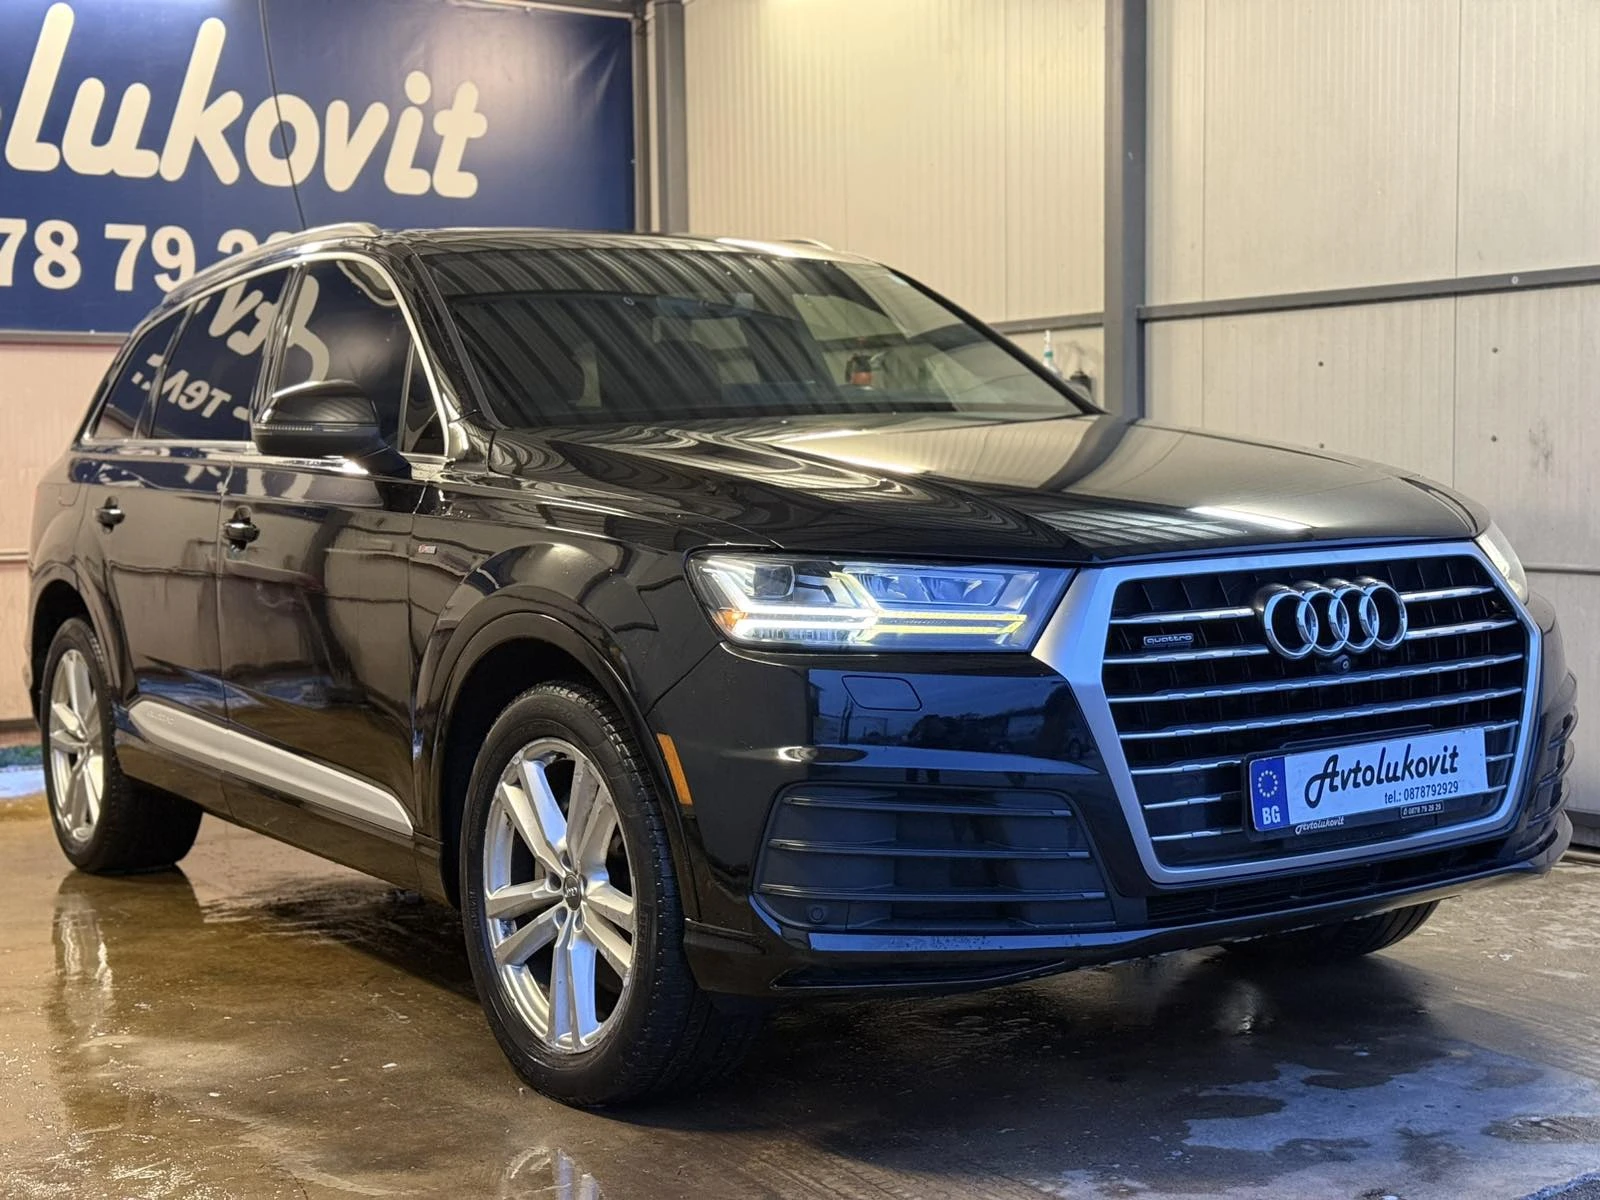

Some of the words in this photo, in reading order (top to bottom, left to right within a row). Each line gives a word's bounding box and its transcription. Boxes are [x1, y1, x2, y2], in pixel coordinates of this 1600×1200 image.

[0, 2, 488, 198] lukovit
[104, 225, 196, 293] 79
[1146, 635, 1192, 644] quattro
[1305, 744, 1459, 808] Avtolukovit
[1403, 780, 1459, 801] 0878792929
[1262, 804, 1281, 825] BG
[1295, 816, 1345, 835] Avtolukovit
